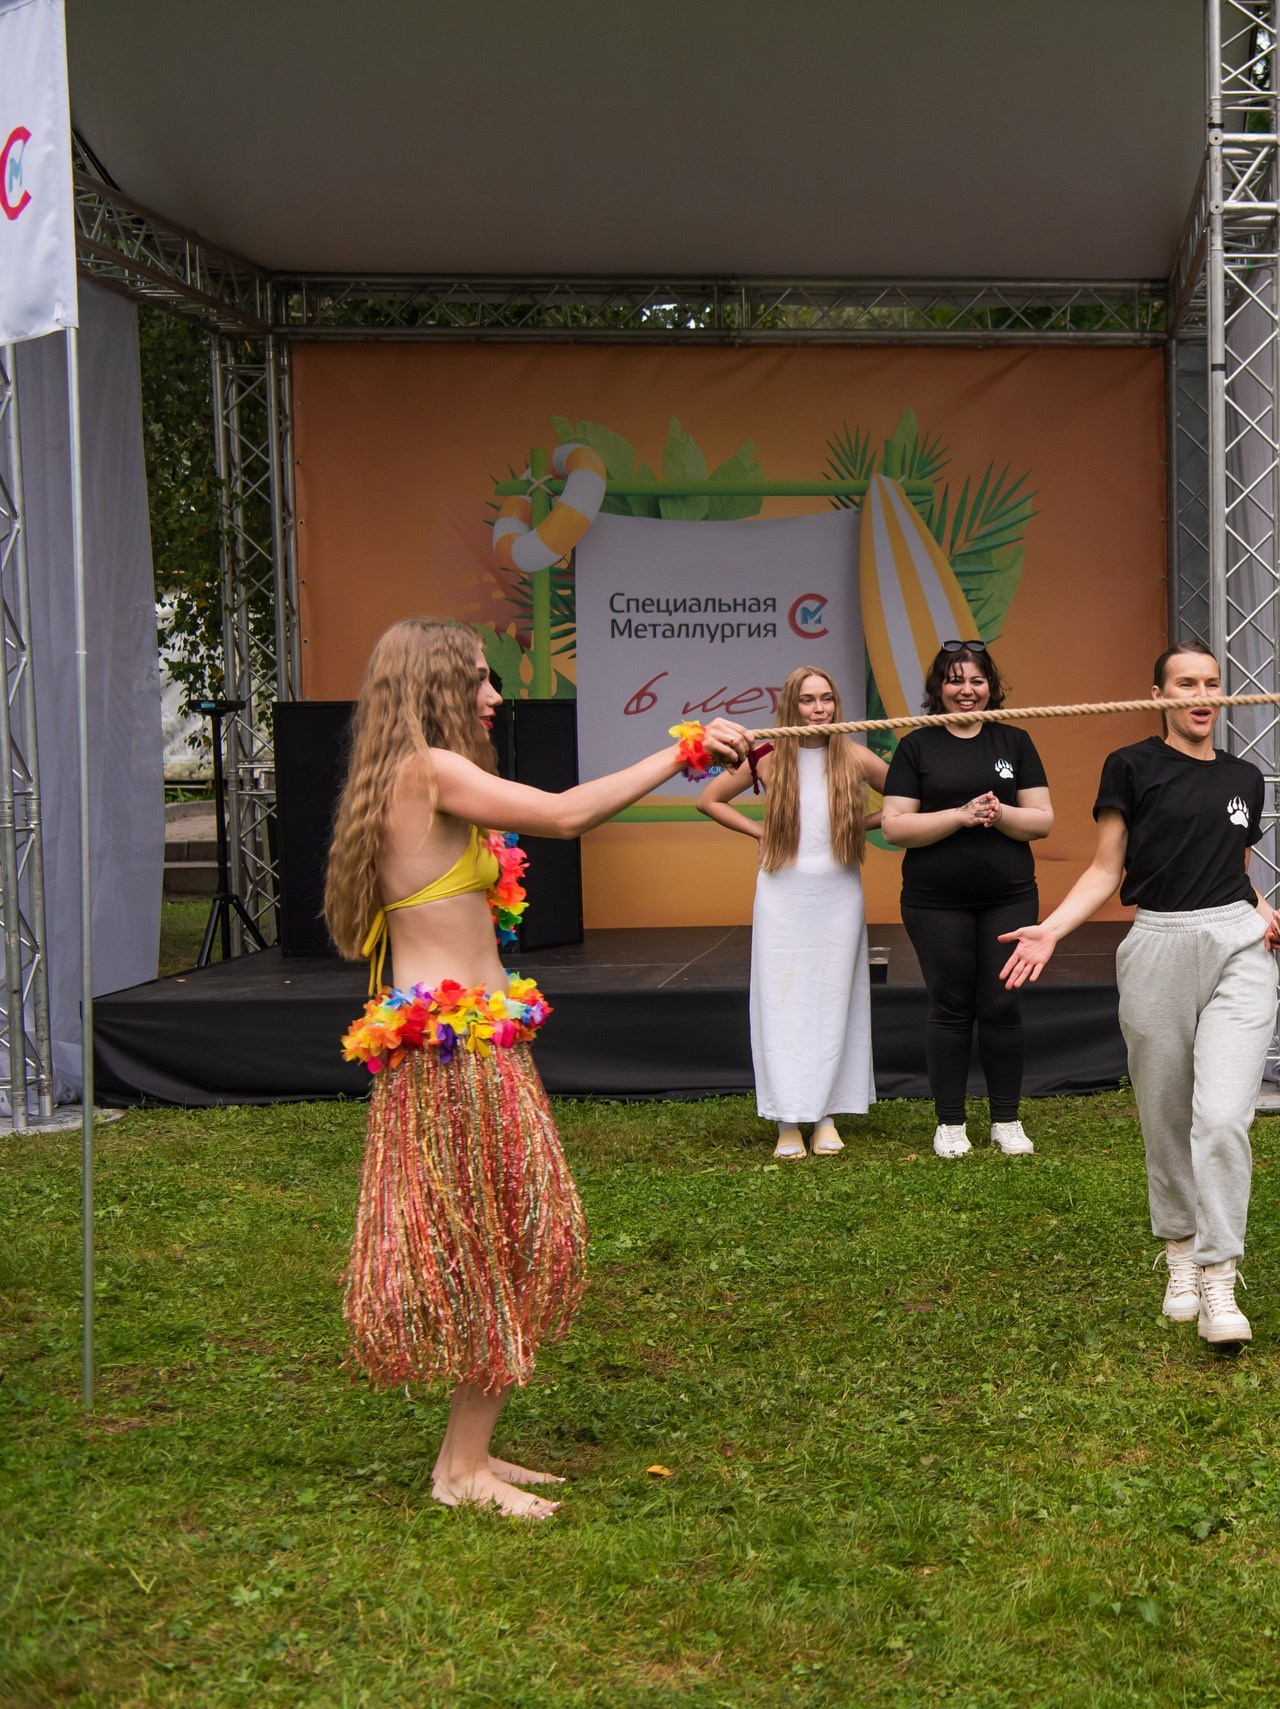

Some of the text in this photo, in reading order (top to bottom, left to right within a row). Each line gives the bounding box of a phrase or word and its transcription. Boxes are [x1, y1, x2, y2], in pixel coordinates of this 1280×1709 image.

[609, 592, 777, 617] Специальная
[610, 618, 777, 644] Металлургия
[623, 671, 669, 716] 6
